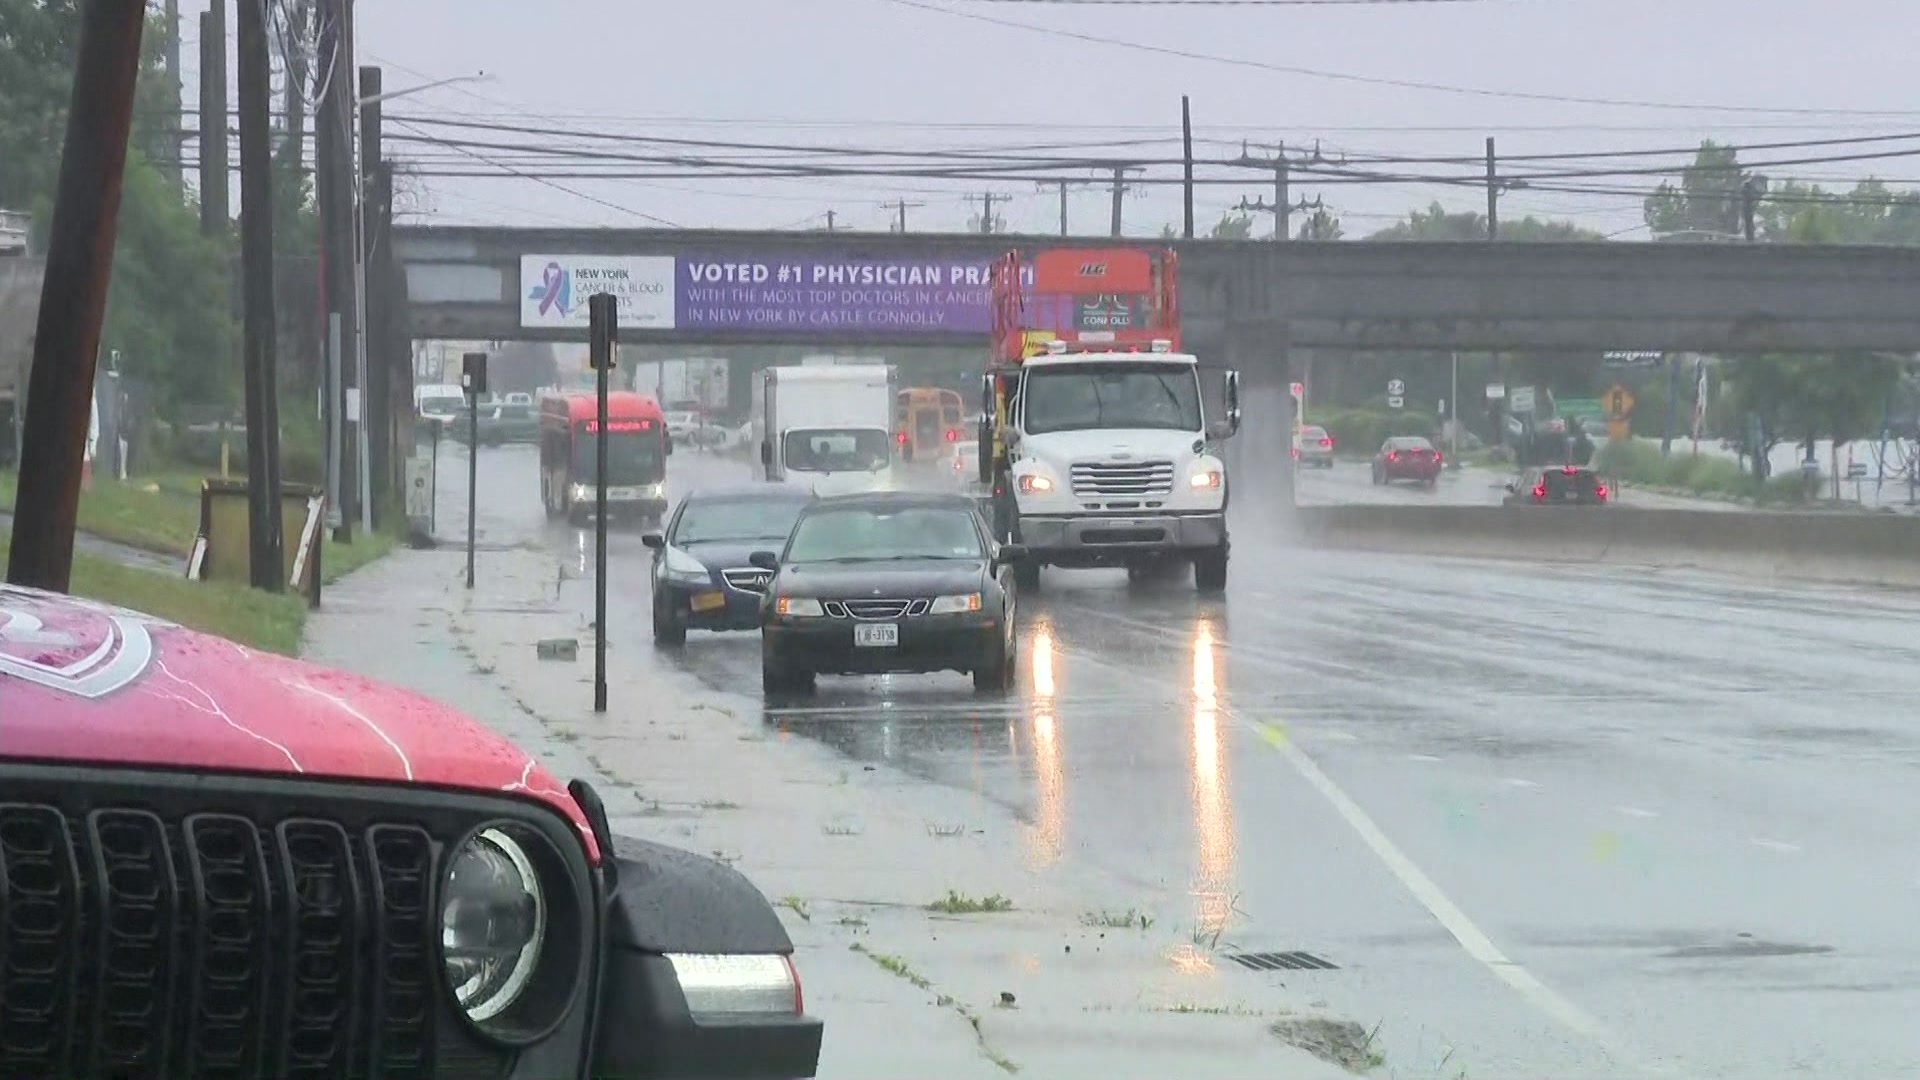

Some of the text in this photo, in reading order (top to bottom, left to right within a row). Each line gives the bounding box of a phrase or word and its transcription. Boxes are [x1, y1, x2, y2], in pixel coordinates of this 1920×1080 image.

[575, 268, 629, 280] NEW YORK
[688, 263, 769, 283] VOTED
[777, 264, 801, 283] #1
[813, 265, 941, 285] PHYSICIAN
[628, 282, 664, 294] BLOOD
[688, 288, 726, 303] WITH
[732, 288, 756, 303] THE
[763, 289, 802, 303] MOST
[809, 290, 836, 303] TOP
[841, 290, 910, 305] DOCTORS
[916, 291, 929, 304] IN
[688, 307, 945, 325] IN NEW YORK BY CASTLE CONNOLLY
